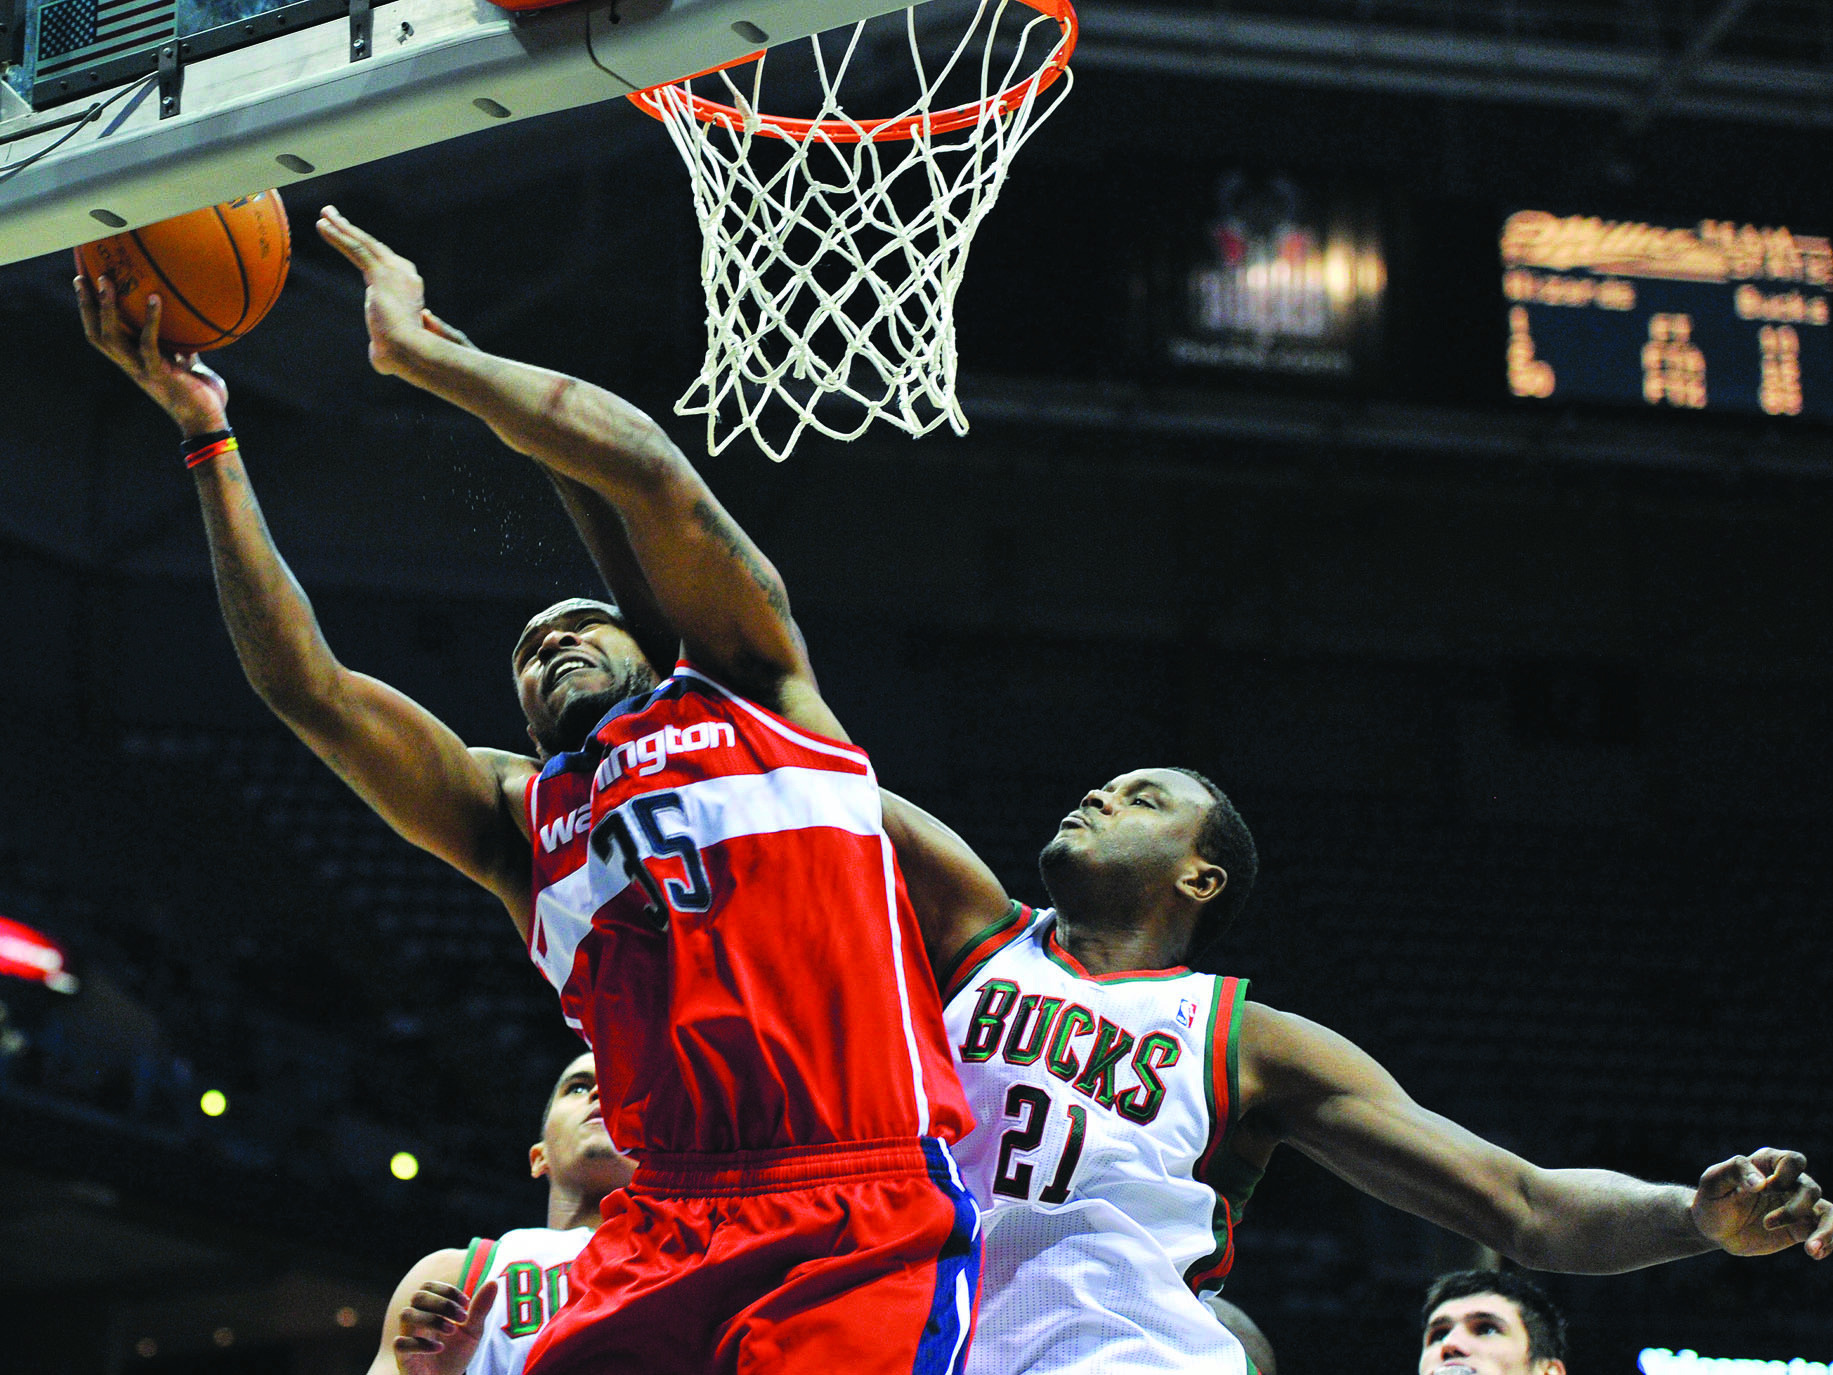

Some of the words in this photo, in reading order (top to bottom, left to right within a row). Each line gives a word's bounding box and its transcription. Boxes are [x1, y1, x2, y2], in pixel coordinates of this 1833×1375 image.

[540, 721, 735, 854] waington
[958, 977, 1182, 1126] BUCKS
[992, 1083, 1087, 1204] 21
